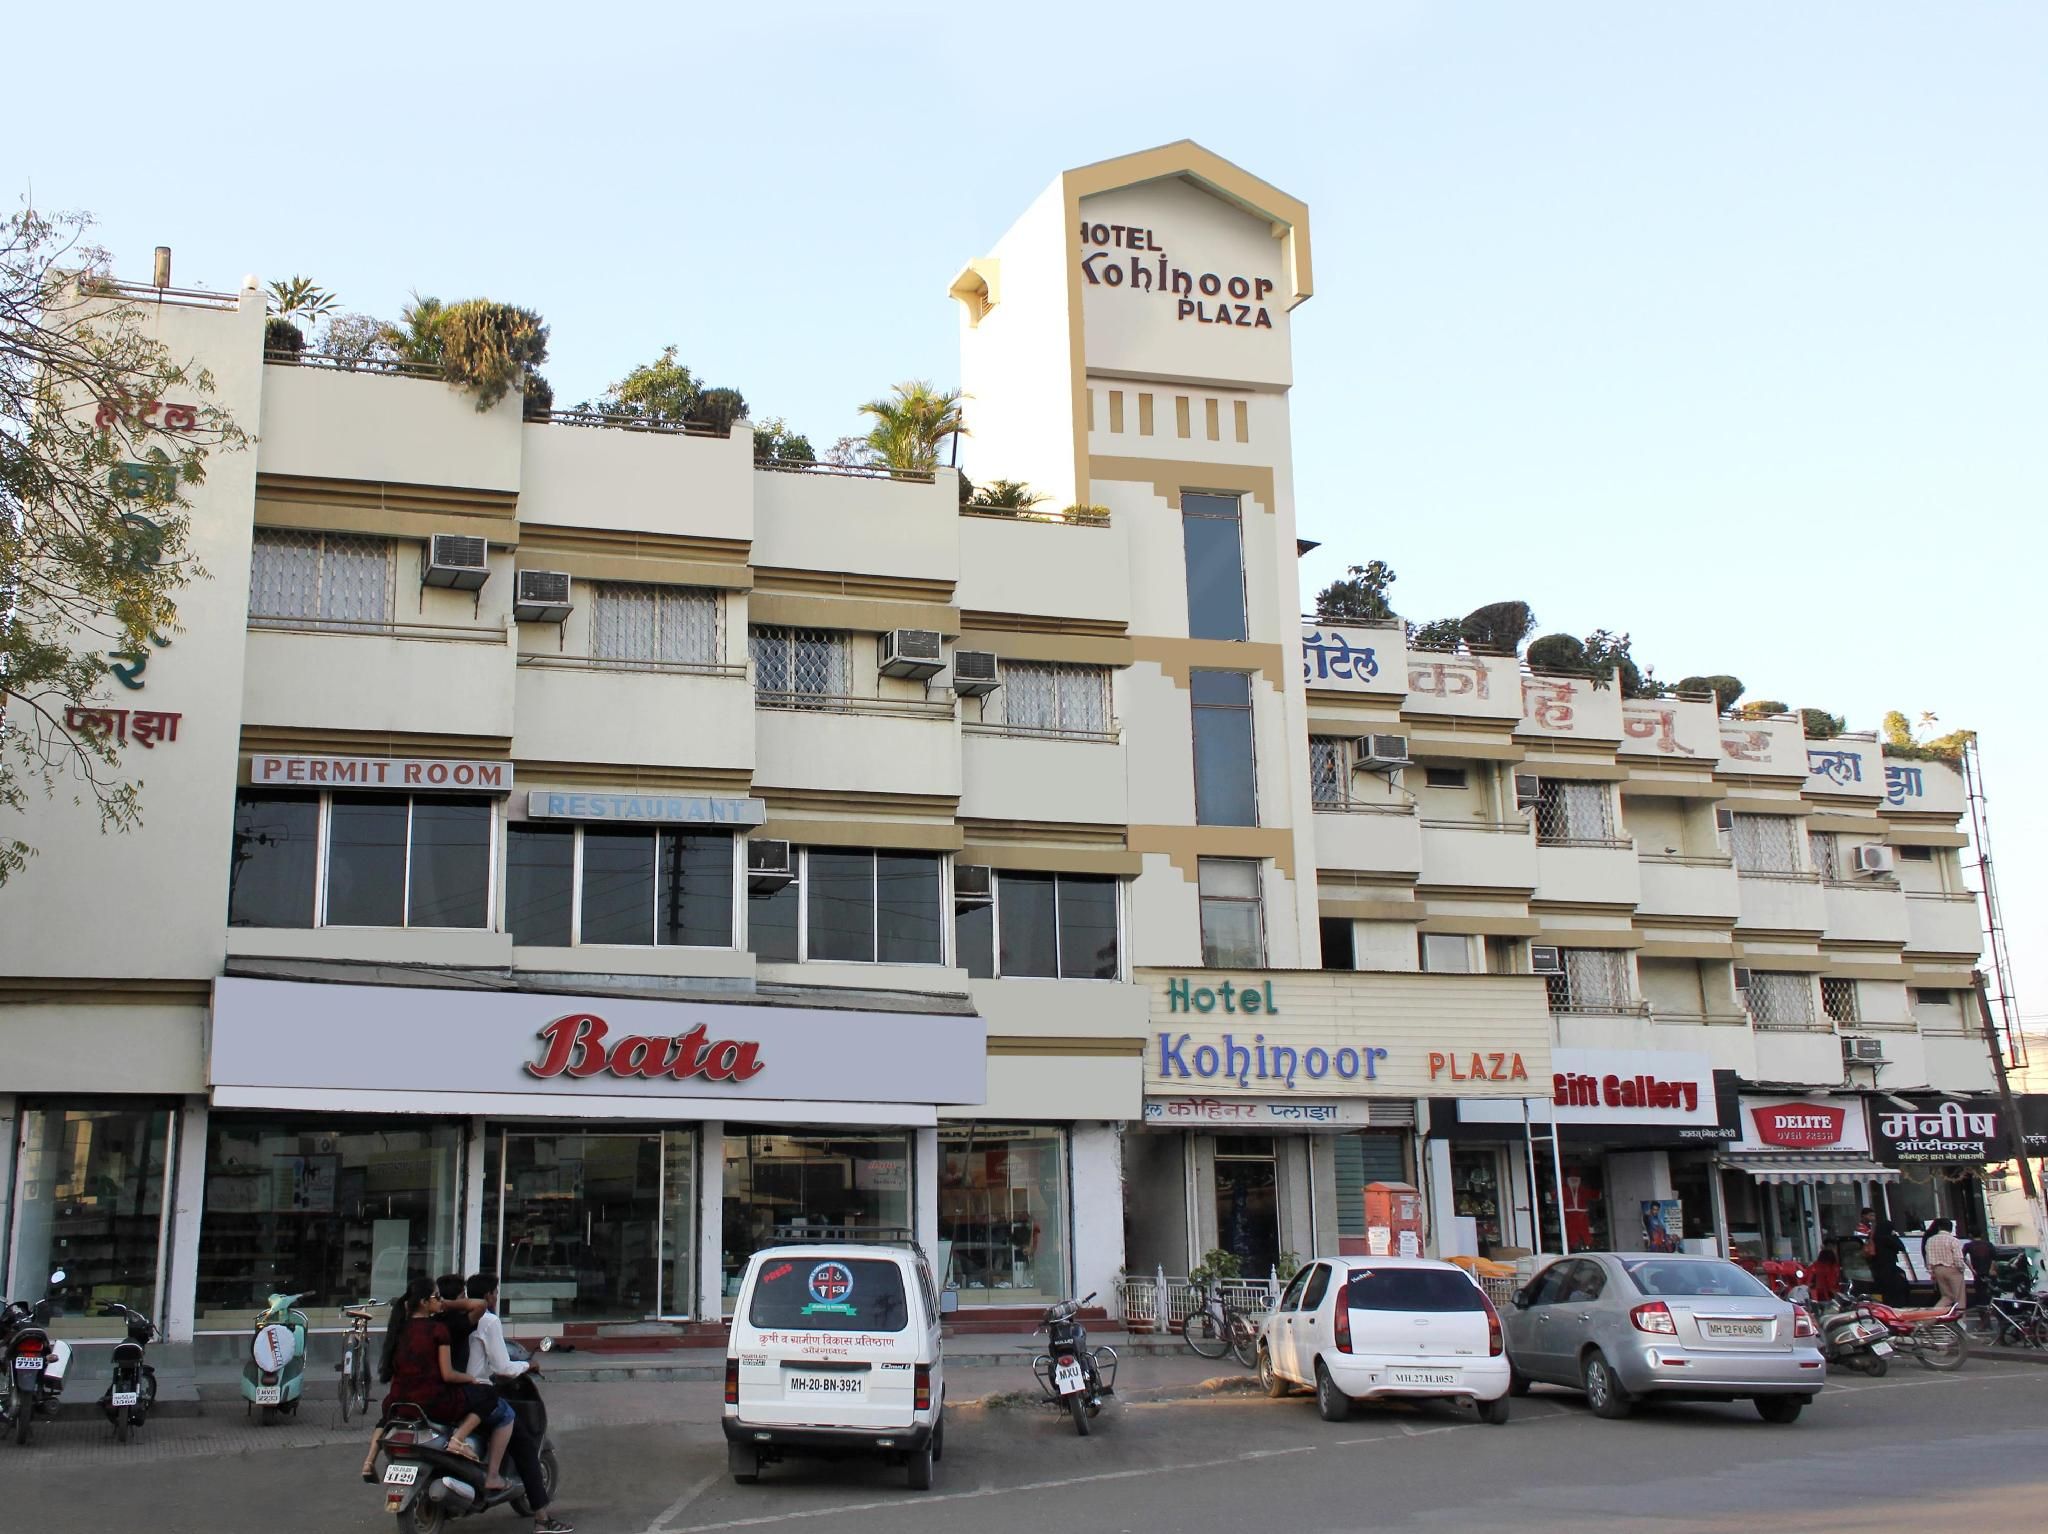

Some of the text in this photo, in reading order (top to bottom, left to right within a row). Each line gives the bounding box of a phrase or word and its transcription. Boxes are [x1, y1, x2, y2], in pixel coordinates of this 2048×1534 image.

[1080, 221, 1163, 252] HOTEL
[1177, 299, 1273, 329] PLAZA
[263, 759, 502, 786] PERMIT ROOM
[549, 794, 745, 822] RESTAURANT
[1168, 977, 1279, 1014] Hotel
[525, 1013, 765, 1082] Bata
[1157, 1033, 1528, 1088] Kohinoor PLAZA
[1553, 1073, 1698, 1112] Gift Gallery
[1775, 1115, 1832, 1129] DELITE
[1879, 1102, 1997, 1138] मनीष
[1777, 1132, 1802, 1140] OVEN
[822, 1333, 852, 1346] विकास
[791, 1377, 862, 1392] MH-20-BN-3921
[1059, 1366, 1079, 1380] MXU
